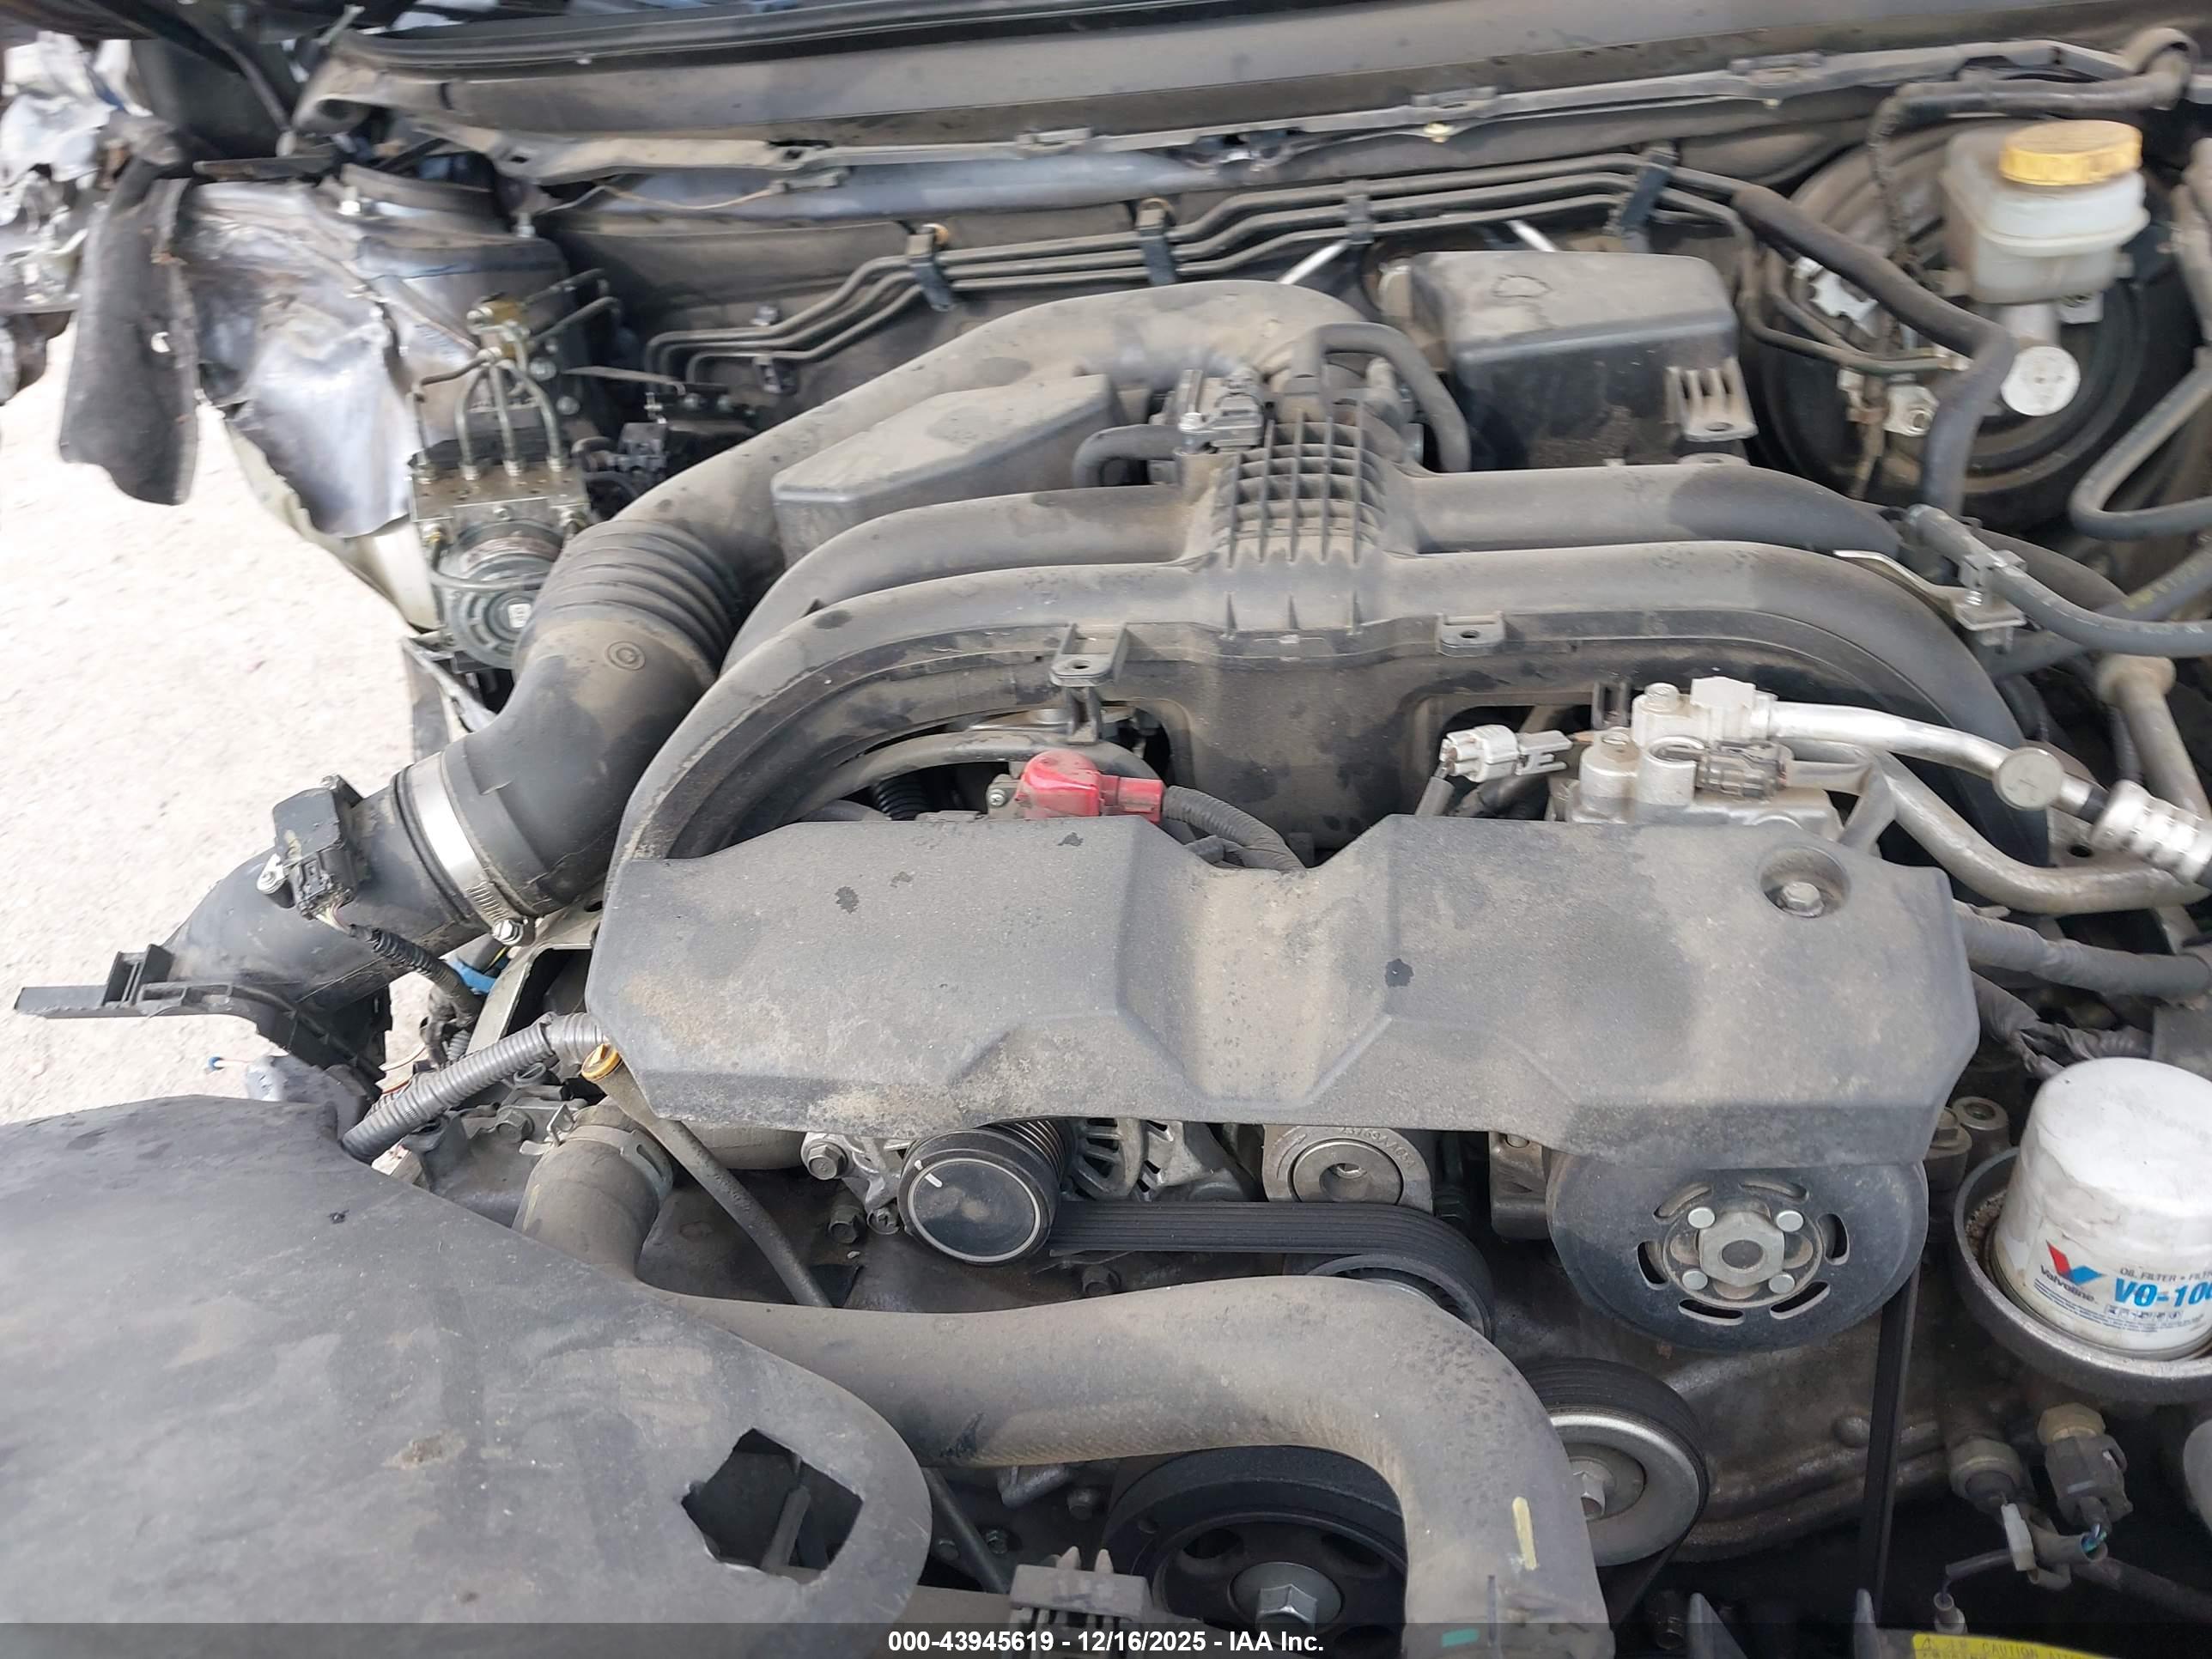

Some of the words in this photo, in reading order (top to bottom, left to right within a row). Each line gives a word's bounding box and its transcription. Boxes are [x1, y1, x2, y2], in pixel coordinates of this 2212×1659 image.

[2040, 1263, 2095, 1303] Valvoline
[2119, 1267, 2137, 1279] OIL
[2141, 1271, 2177, 1282] FILTER
[1981, 1641, 2039, 1659] CAUTION
